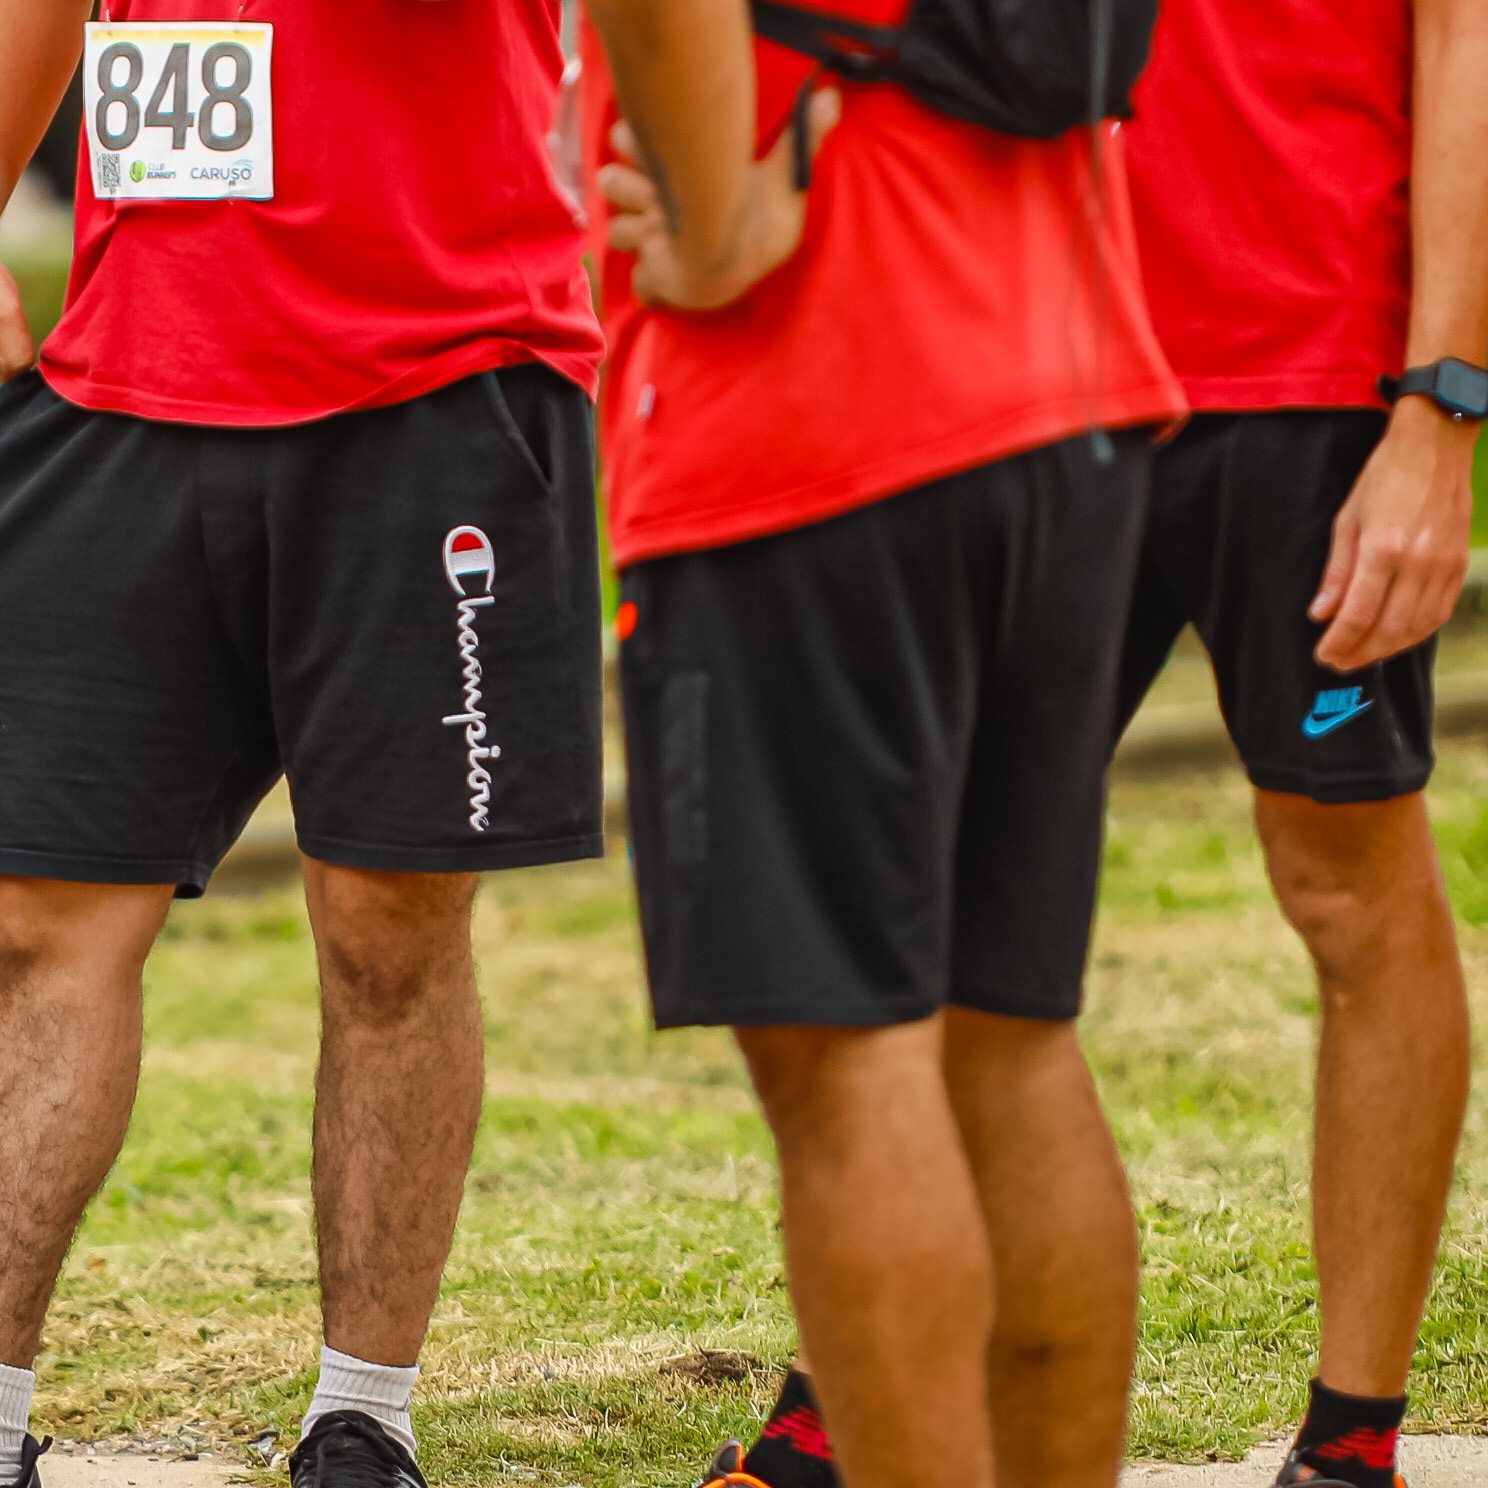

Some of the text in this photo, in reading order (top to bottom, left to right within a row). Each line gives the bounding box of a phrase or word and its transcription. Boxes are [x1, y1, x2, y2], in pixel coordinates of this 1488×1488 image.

[96, 41, 254, 152] 848
[190, 167, 253, 181] CARUSO
[442, 525, 502, 832] Champion
